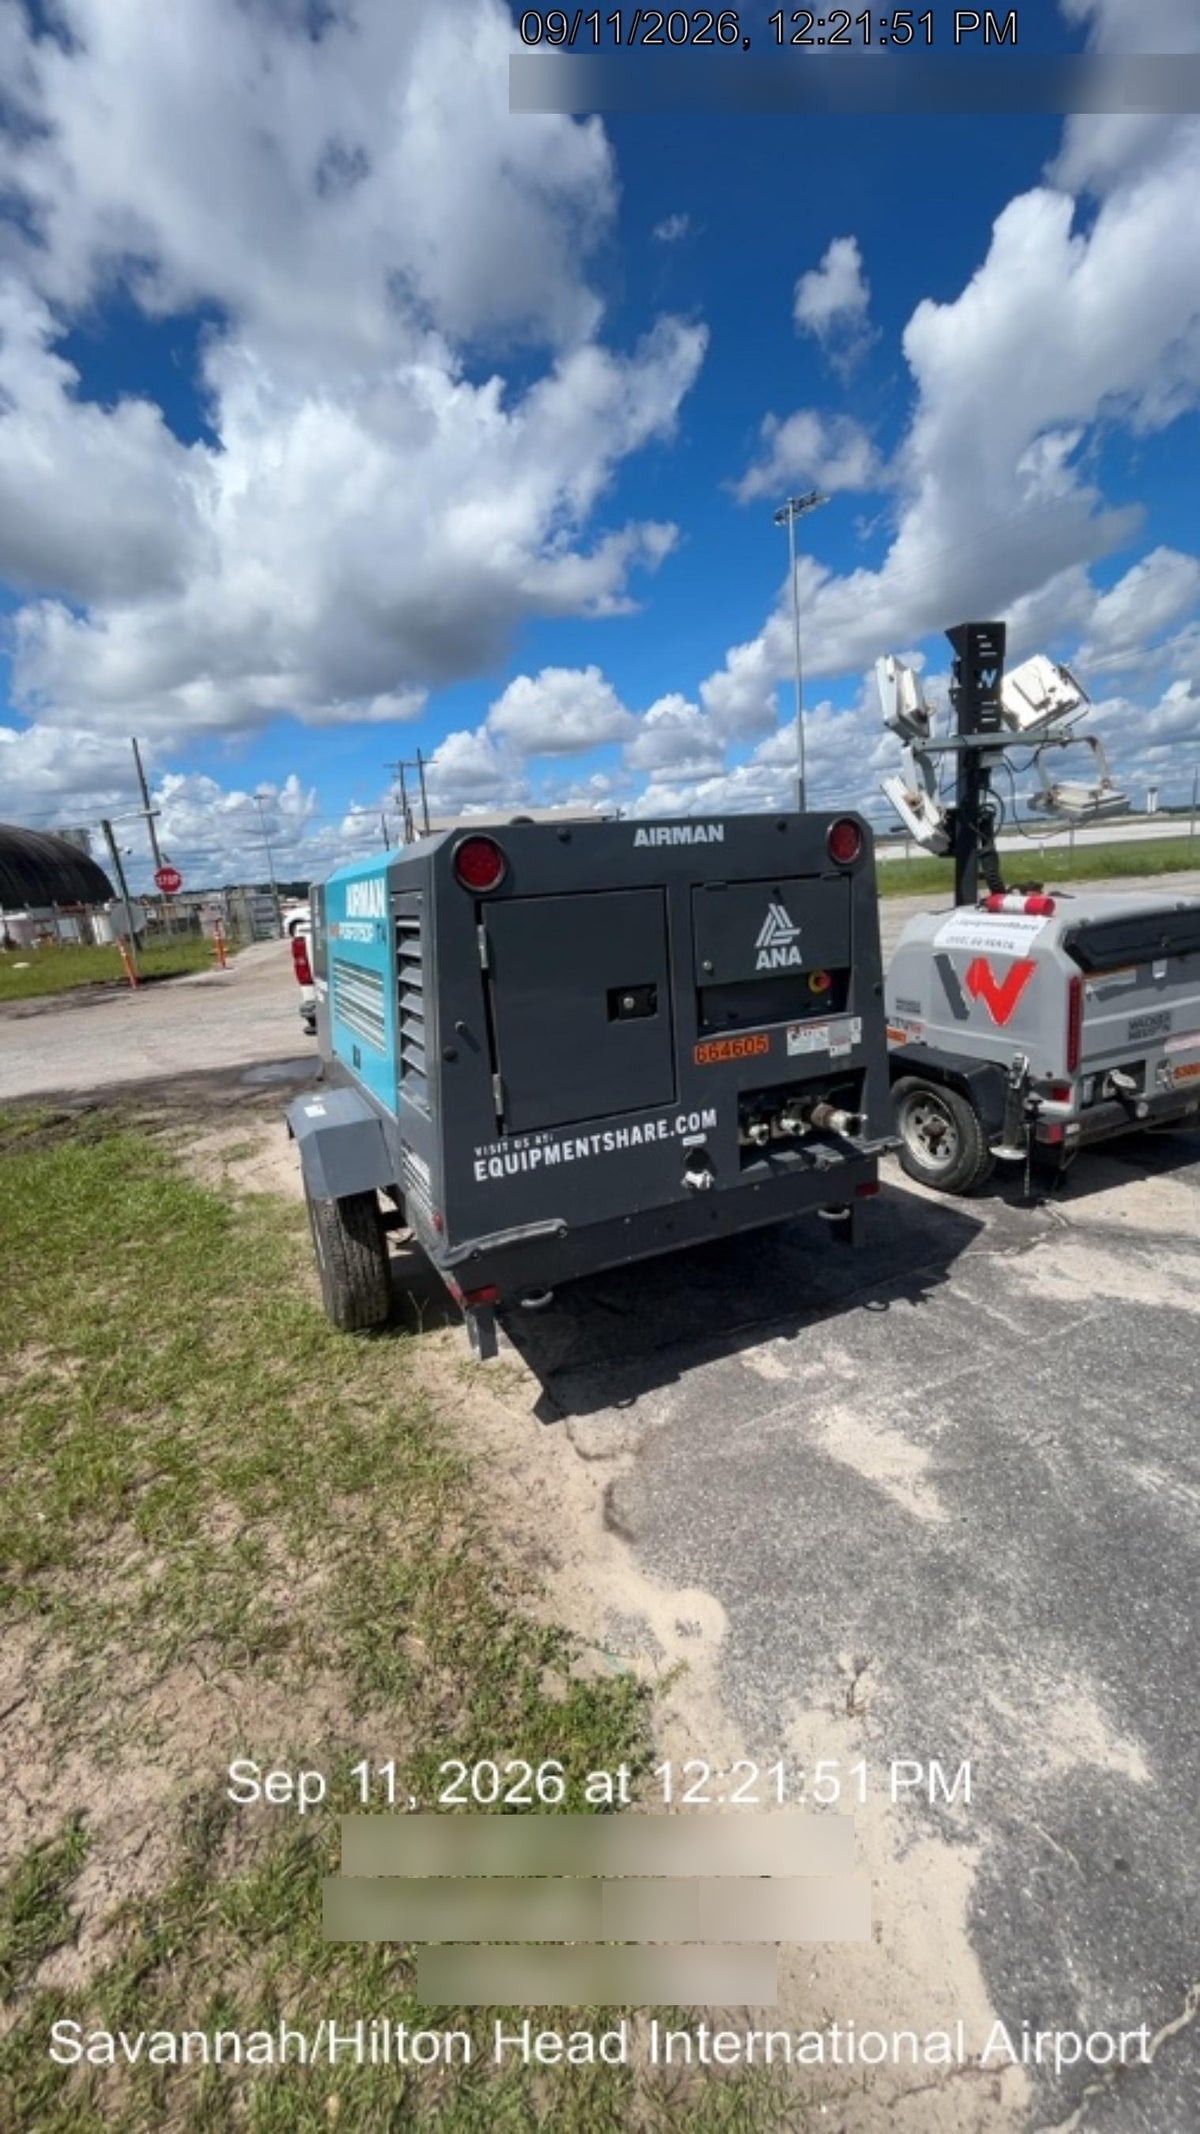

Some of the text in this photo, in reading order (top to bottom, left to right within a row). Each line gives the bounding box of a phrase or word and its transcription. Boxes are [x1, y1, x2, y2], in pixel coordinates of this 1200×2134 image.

[633, 824, 725, 847] AIRMAN
[755, 945, 803, 971] ANA
[696, 1034, 767, 1064] 664605
[473, 1108, 717, 1182] EQUIPMENTSHARE.COM
